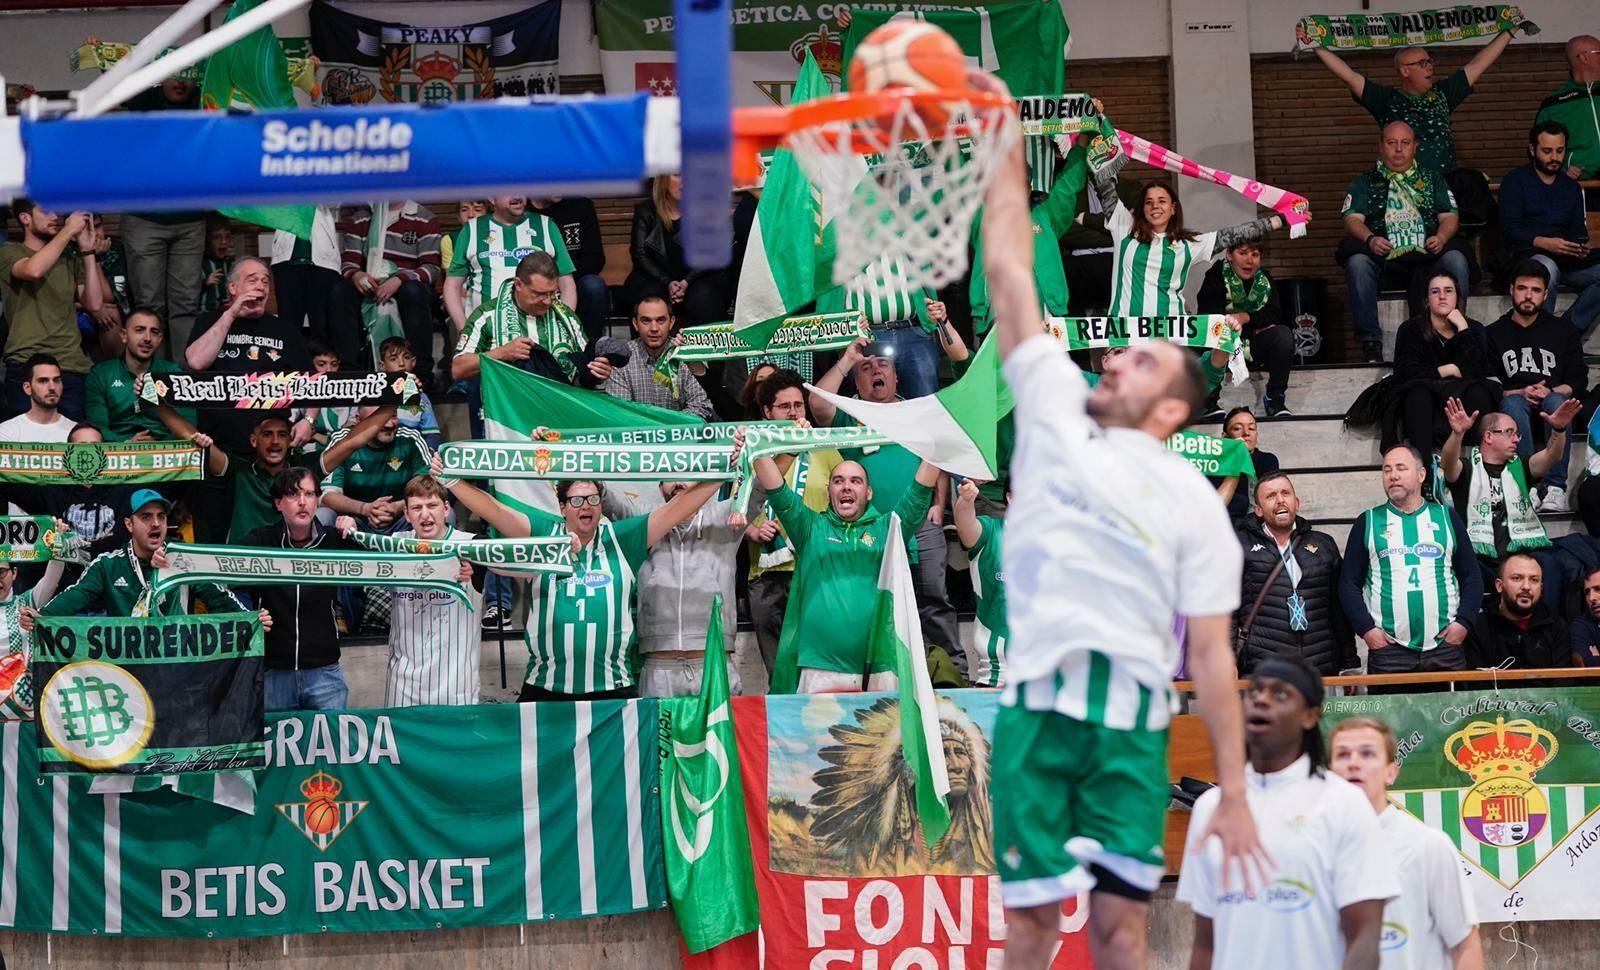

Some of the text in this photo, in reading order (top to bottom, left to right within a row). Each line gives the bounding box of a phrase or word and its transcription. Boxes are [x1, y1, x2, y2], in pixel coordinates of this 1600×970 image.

[1389, 6, 1498, 34] VALDEMORO
[400, 27, 475, 44] PEAKY
[1019, 98, 1096, 121] ALDEMO
[262, 117, 413, 152] Schelde
[260, 150, 411, 176] International
[1076, 315, 1199, 341] REAL BETIS
[226, 334, 283, 350] HOMBRE SENCILLO
[1502, 346, 1557, 378] GAP
[169, 371, 388, 403] Real Betis Balompié
[621, 429, 667, 445] BETIS
[1172, 433, 1224, 455] Betis
[107, 455, 140, 470] DEL
[152, 451, 201, 469] BETIS
[444, 446, 732, 474] GRADA BETIS BASKET
[1417, 545, 1438, 555] plus
[218, 555, 282, 575] REAL
[290, 559, 364, 578] BETIS
[1408, 567, 1421, 588] 4
[428, 590, 452, 601] plus
[575, 598, 586, 621] 1
[37, 620, 254, 661] NO SURRENDER
[1439, 696, 1558, 726] Cultural
[160, 857, 491, 919] BETIS BASKET
[1503, 891, 1525, 909] de
